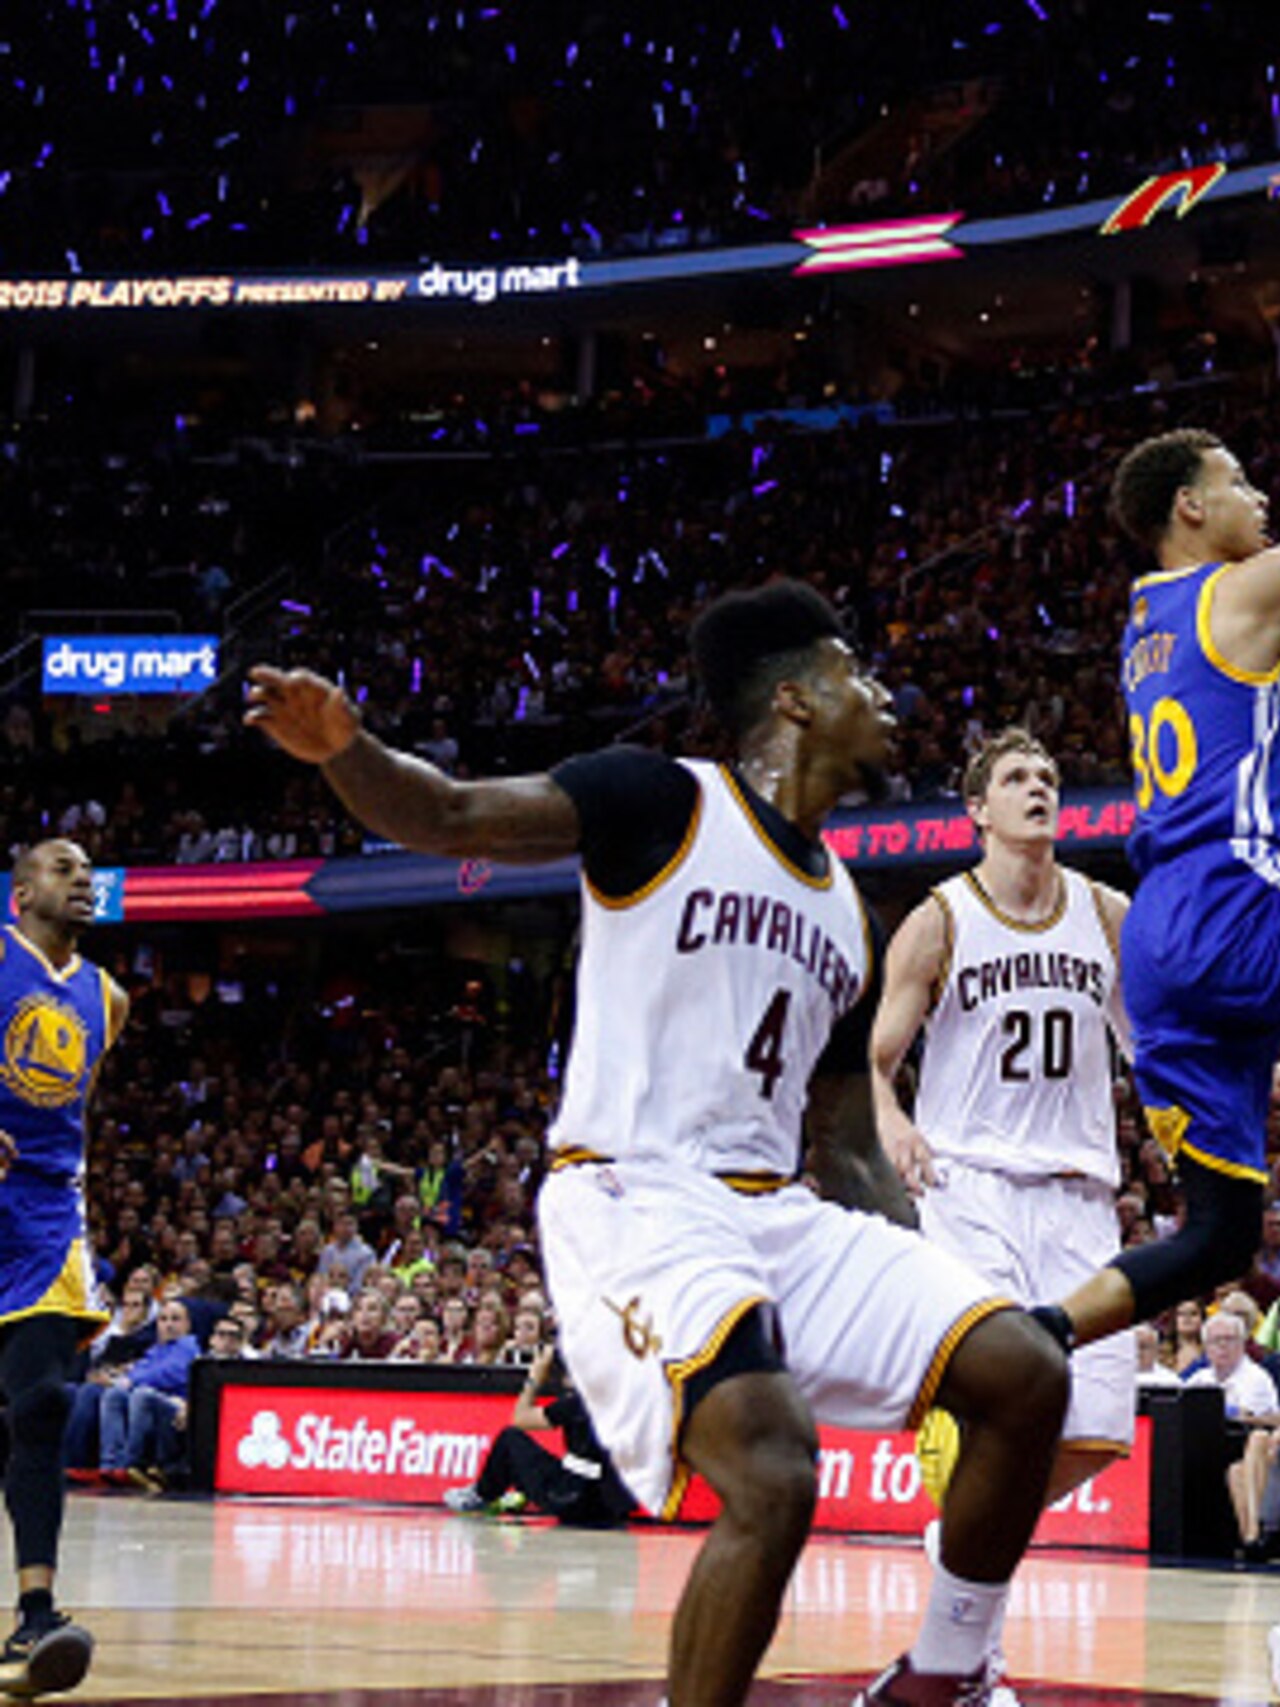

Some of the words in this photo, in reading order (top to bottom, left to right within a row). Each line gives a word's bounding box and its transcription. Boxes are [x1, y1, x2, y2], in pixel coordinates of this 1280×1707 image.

[69, 275, 234, 307] PLAYOFFS
[236, 281, 370, 302] PRESENTED
[375, 279, 407, 300] BY
[418, 261, 497, 302] drug
[501, 256, 581, 292] mart
[46, 643, 126, 688] drug
[133, 644, 216, 678] mart
[1130, 696, 1199, 812] 30
[868, 821, 910, 856] TO
[914, 816, 976, 852] THE
[1055, 801, 1138, 841] PLAY
[957, 952, 1106, 1012] CAVALIERS
[743, 986, 793, 1101] 4
[1002, 1009, 1075, 1083] 20
[868, 1439, 924, 1503] to
